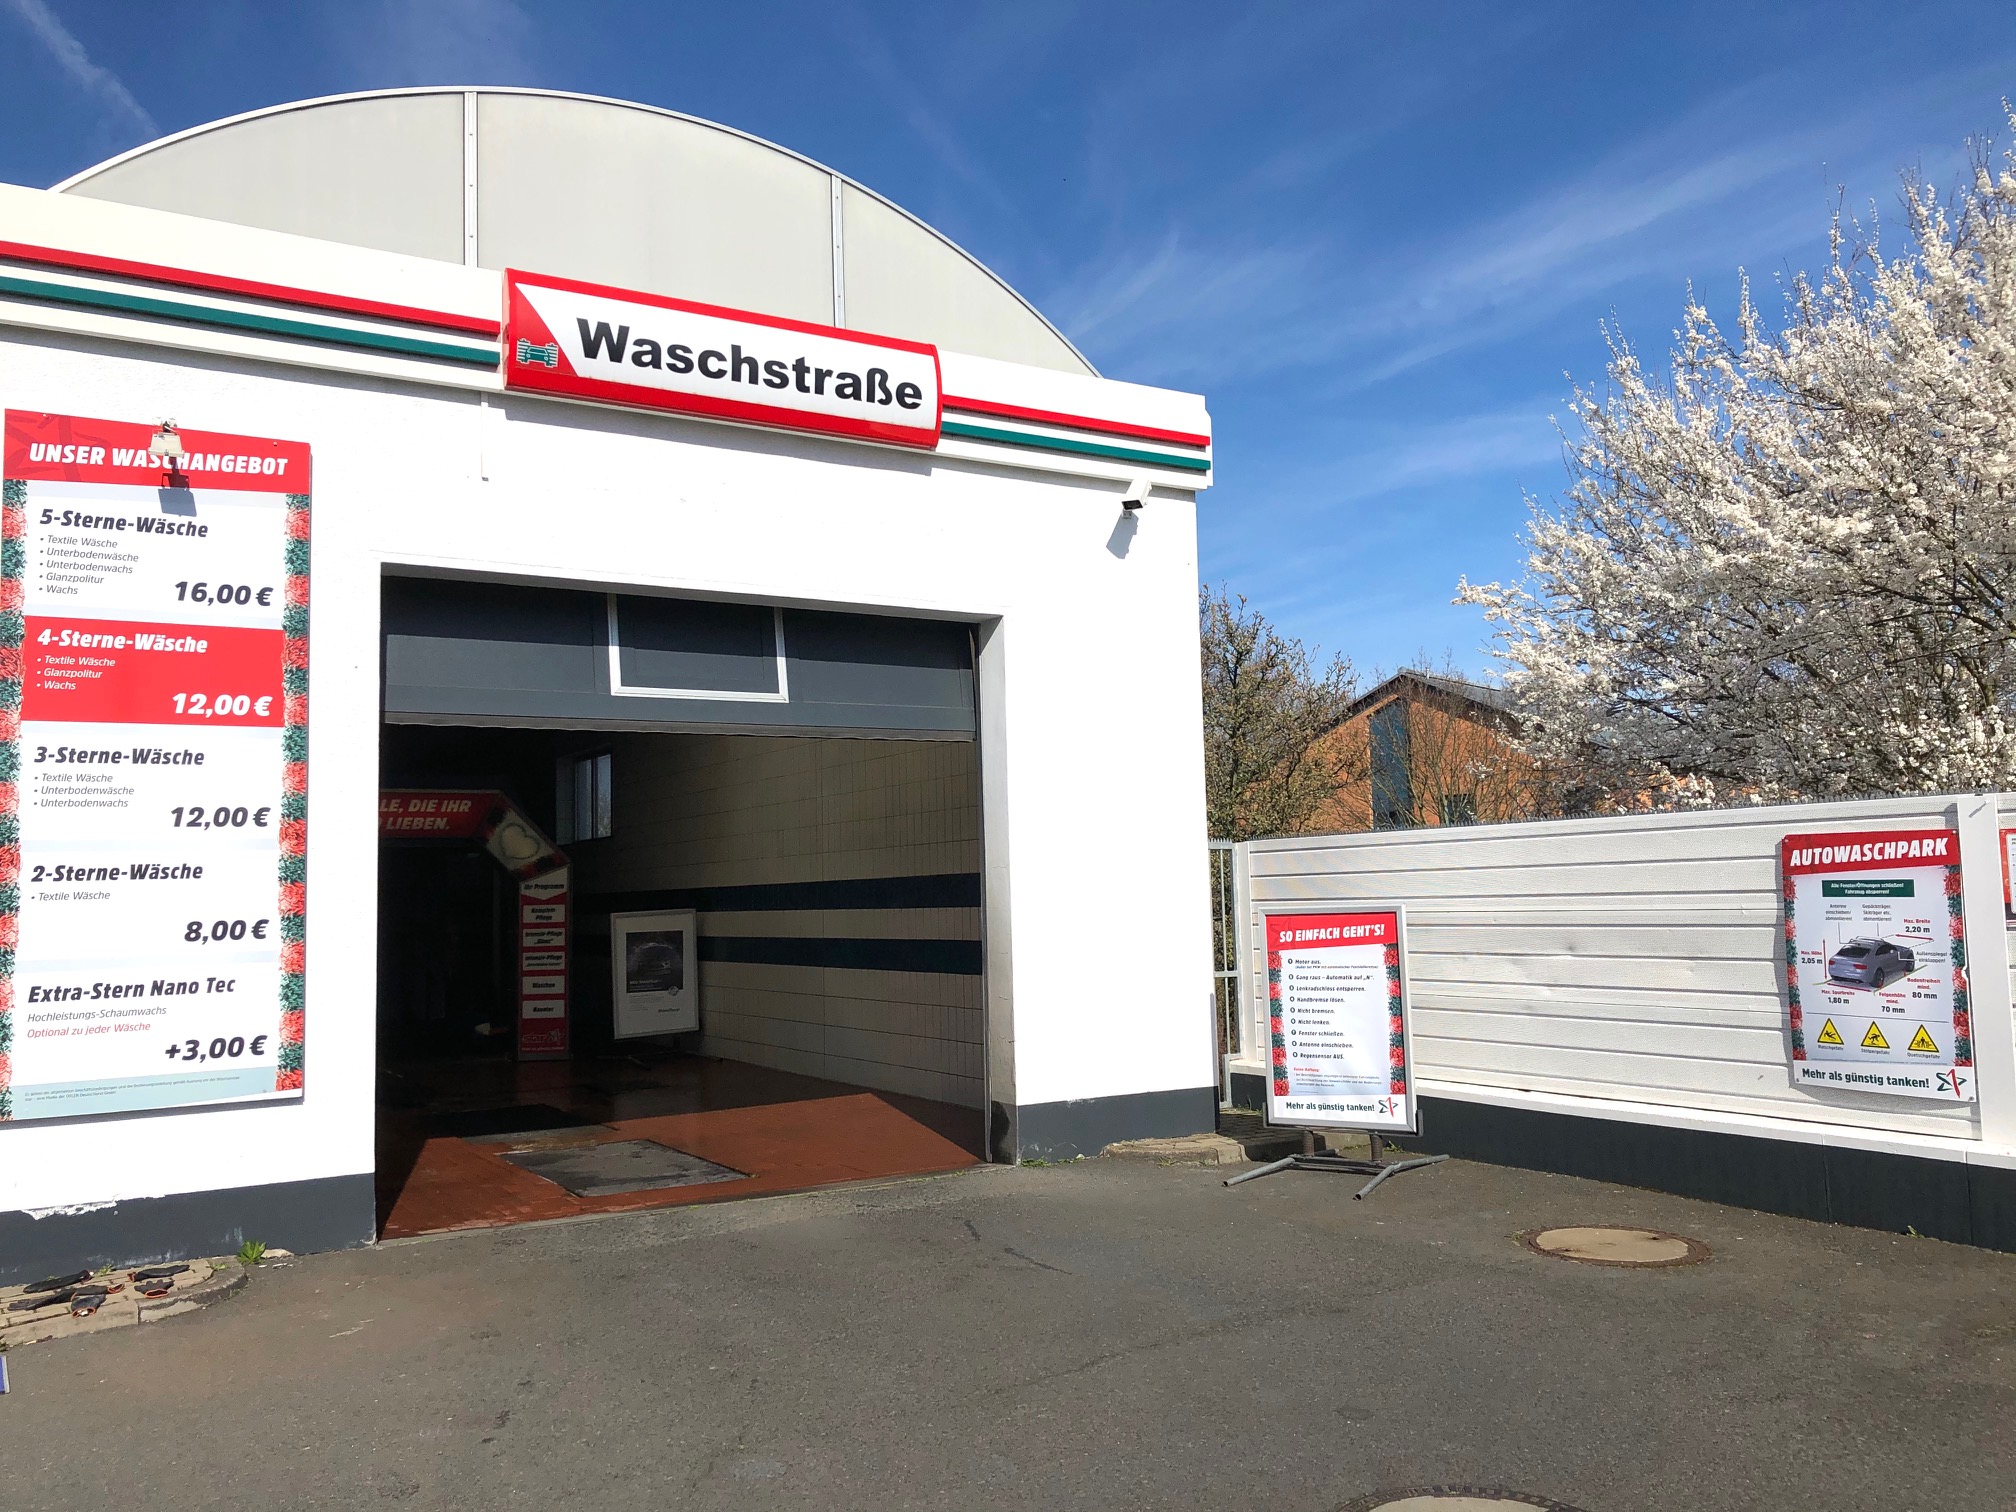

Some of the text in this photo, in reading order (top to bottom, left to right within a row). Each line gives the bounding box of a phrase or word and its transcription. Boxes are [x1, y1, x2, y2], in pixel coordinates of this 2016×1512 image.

[576, 317, 922, 409] Waschstraße
[29, 442, 105, 465] UNSER
[40, 508, 208, 538] 5-Sterne-Wäsche
[48, 534, 118, 548] Textile Wäsche
[46, 548, 139, 562] Unterbodenwäsche
[46, 560, 133, 574] Unterbodenwachs
[46, 572, 104, 585] Glanzpolitur
[46, 585, 78, 595] Wachs
[175, 581, 273, 606] 16,00 €
[37, 628, 208, 654] 4-Sterne-Wäsche
[44, 655, 115, 667] Textile Wäsche
[44, 667, 102, 679] Glanzpolitur
[44, 681, 76, 690] Wachs
[173, 693, 273, 718] 12,00 €
[34, 746, 204, 766] 3-Sterne-Wäsche
[42, 773, 113, 782] Textile Wäsche
[41, 786, 134, 795] Unterbodenwäsche
[41, 798, 128, 808] Unterbodenwachs
[408, 800, 438, 812] DIE
[441, 800, 472, 812] IHR
[171, 807, 271, 830] 12,00 €
[386, 817, 451, 830] LIEBEN.
[1790, 838, 1948, 867] AUTOWASCHPARK
[31, 864, 203, 882] 2-Sterne-Wäsche
[38, 890, 110, 901] Textile Wäsche
[184, 919, 269, 944] 8,00 €
[1280, 924, 1385, 943] SO EINFACH GEHT'S!
[1905, 926, 1921, 934] 2,20
[28, 978, 235, 1003] Extra-Stern Nano Tec
[1828, 997, 1842, 1005] 1,80
[27, 1006, 167, 1023] Hochleistungs-Schaumwachs
[27, 1022, 150, 1039] Optional zu jeder Wäsche
[165, 1035, 268, 1063] +3,00 €
[1802, 1068, 1930, 1088] Mehr als günstig tanken!
[1318, 1103, 1344, 1112] günstig
[1347, 1104, 1375, 1112] tanken!
